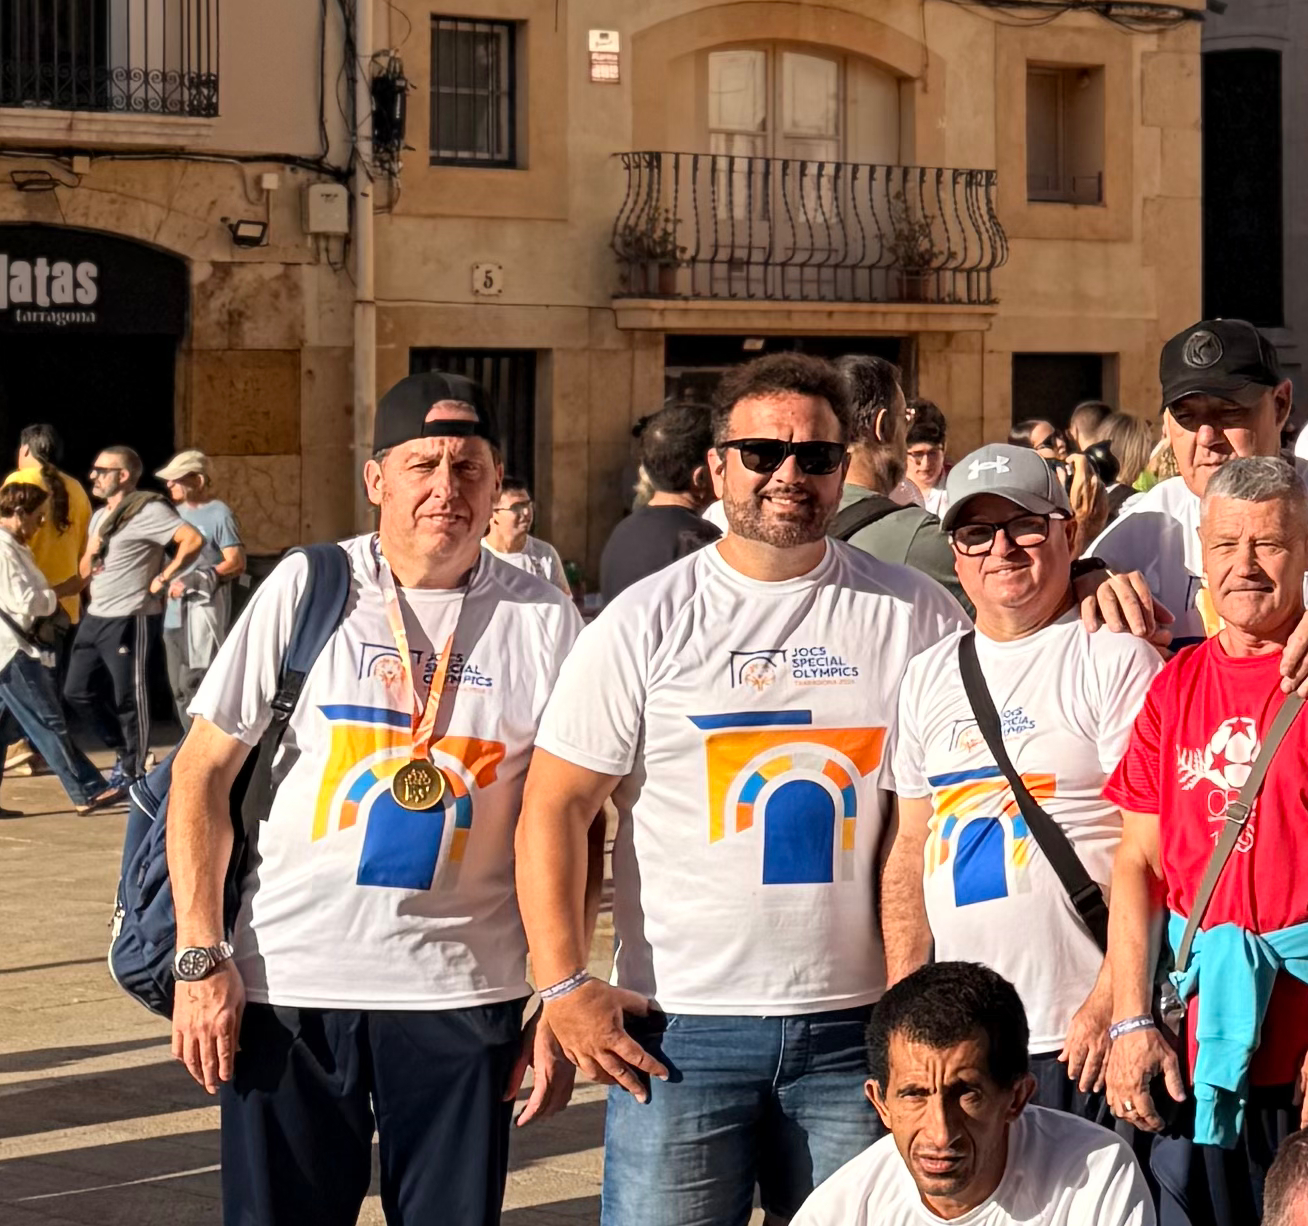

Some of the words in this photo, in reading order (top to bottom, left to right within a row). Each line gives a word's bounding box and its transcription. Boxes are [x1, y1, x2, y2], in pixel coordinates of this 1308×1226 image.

[483, 270, 494, 289] 5
[16, 309, 97, 326] tarragona
[791, 646, 827, 657] JOCS
[791, 656, 847, 669] SPECIAL
[792, 666, 859, 679] OLYMPICS
